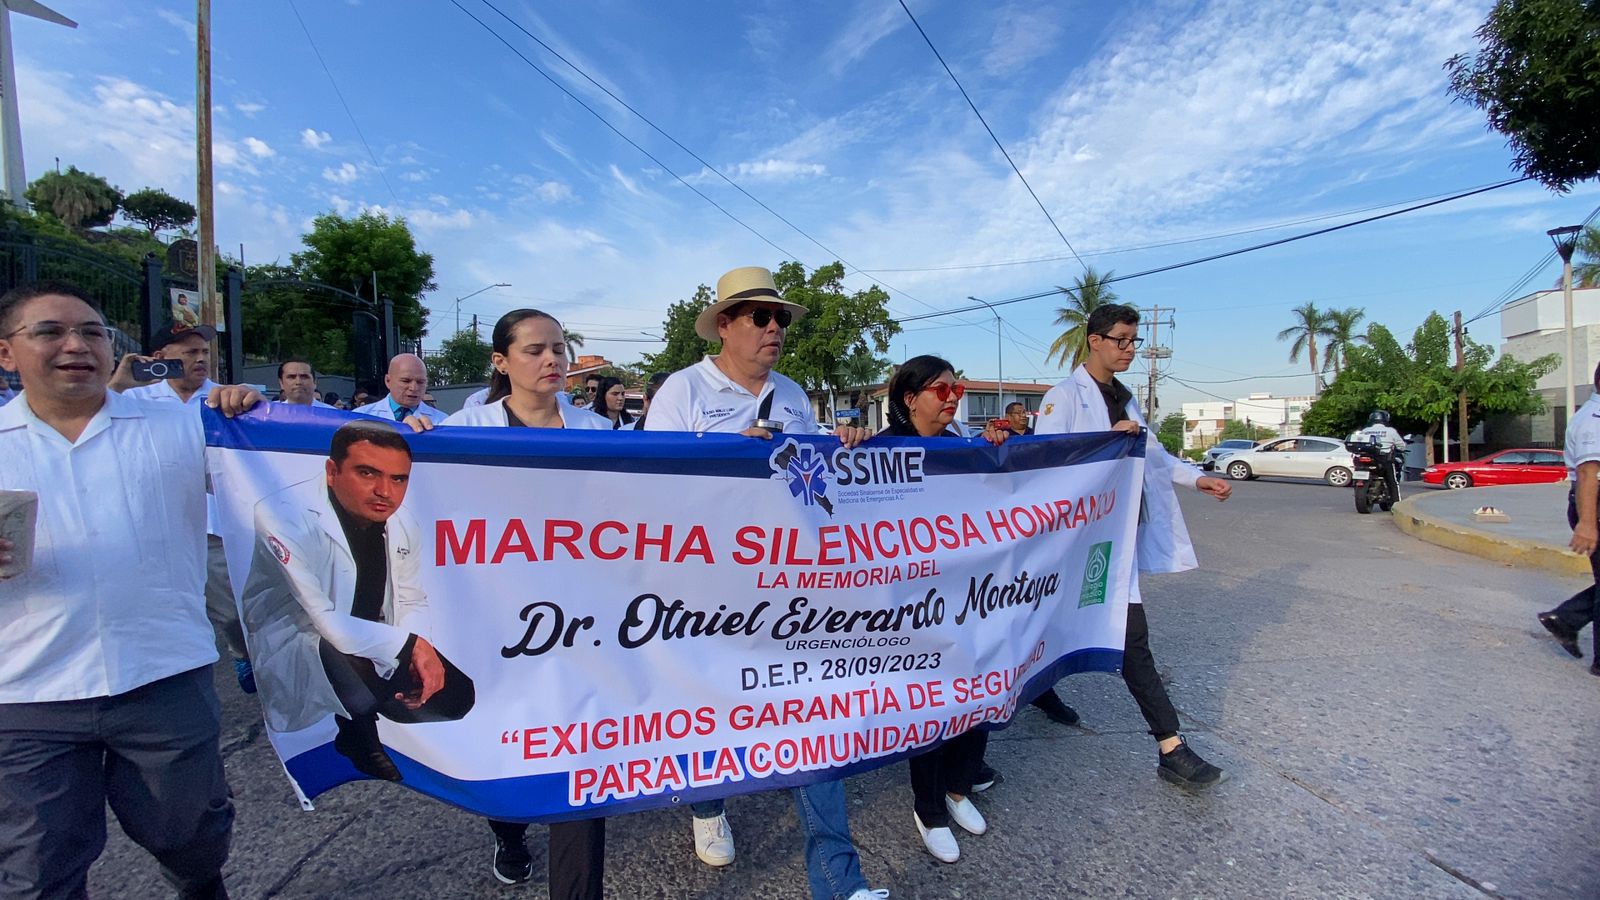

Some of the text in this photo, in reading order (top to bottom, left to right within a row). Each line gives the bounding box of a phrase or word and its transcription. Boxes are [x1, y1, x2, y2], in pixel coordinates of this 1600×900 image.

[836, 451, 923, 486] SSIME
[435, 519, 715, 567] MARCHA
[732, 513, 987, 566] SILENCIOSA
[757, 559, 941, 589] LA MEMORIA DEL
[501, 601, 601, 659] Dr.
[618, 593, 771, 649] Otniel
[771, 587, 945, 641] Everardo
[955, 570, 1060, 626] Montoya
[785, 635, 911, 651] URGENCIÓLOGO
[741, 651, 942, 691] D.E.P. 28/09/2023
[501, 706, 716, 760] “EXIGIMOS
[729, 681, 901, 731] GARANTÍA
[907, 680, 945, 710] DE
[574, 755, 682, 801] PARA
[693, 747, 740, 783] LA
[750, 719, 940, 773] COMUNIDAD
